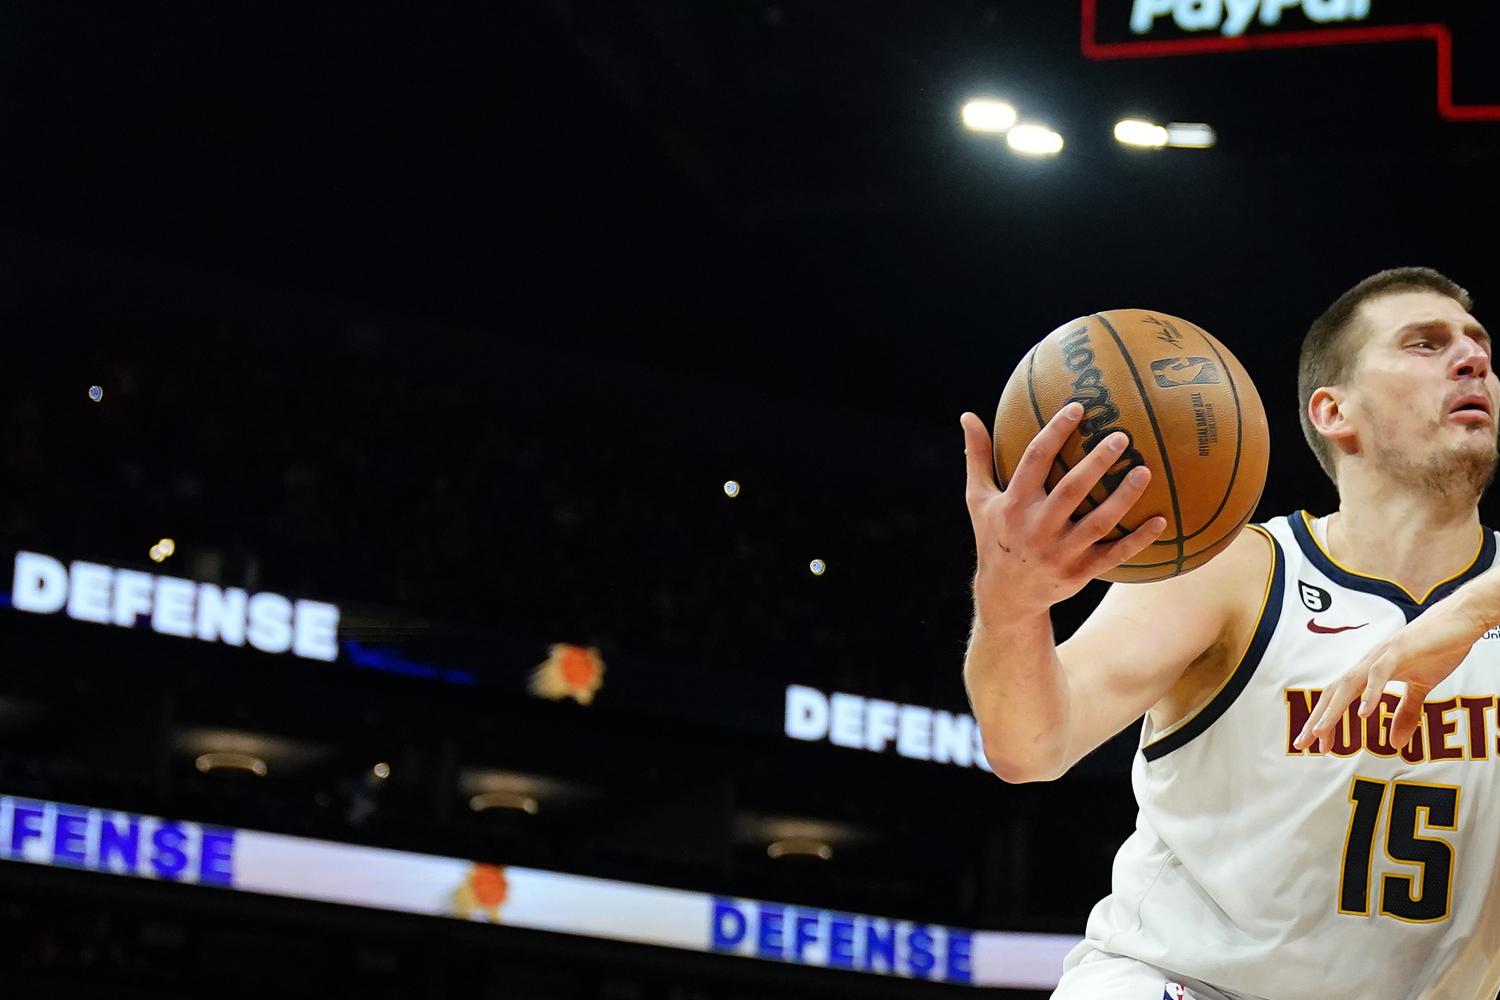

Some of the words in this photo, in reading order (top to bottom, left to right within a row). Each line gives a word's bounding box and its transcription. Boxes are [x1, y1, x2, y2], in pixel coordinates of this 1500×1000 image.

[1196, 427, 1209, 457] OFFICIAL
[12, 550, 340, 662] DEFENSE
[784, 685, 993, 773] DEFEN
[12, 806, 235, 888] FENSE
[1337, 774, 1462, 924] 15
[712, 903, 974, 983] DEFENSE
